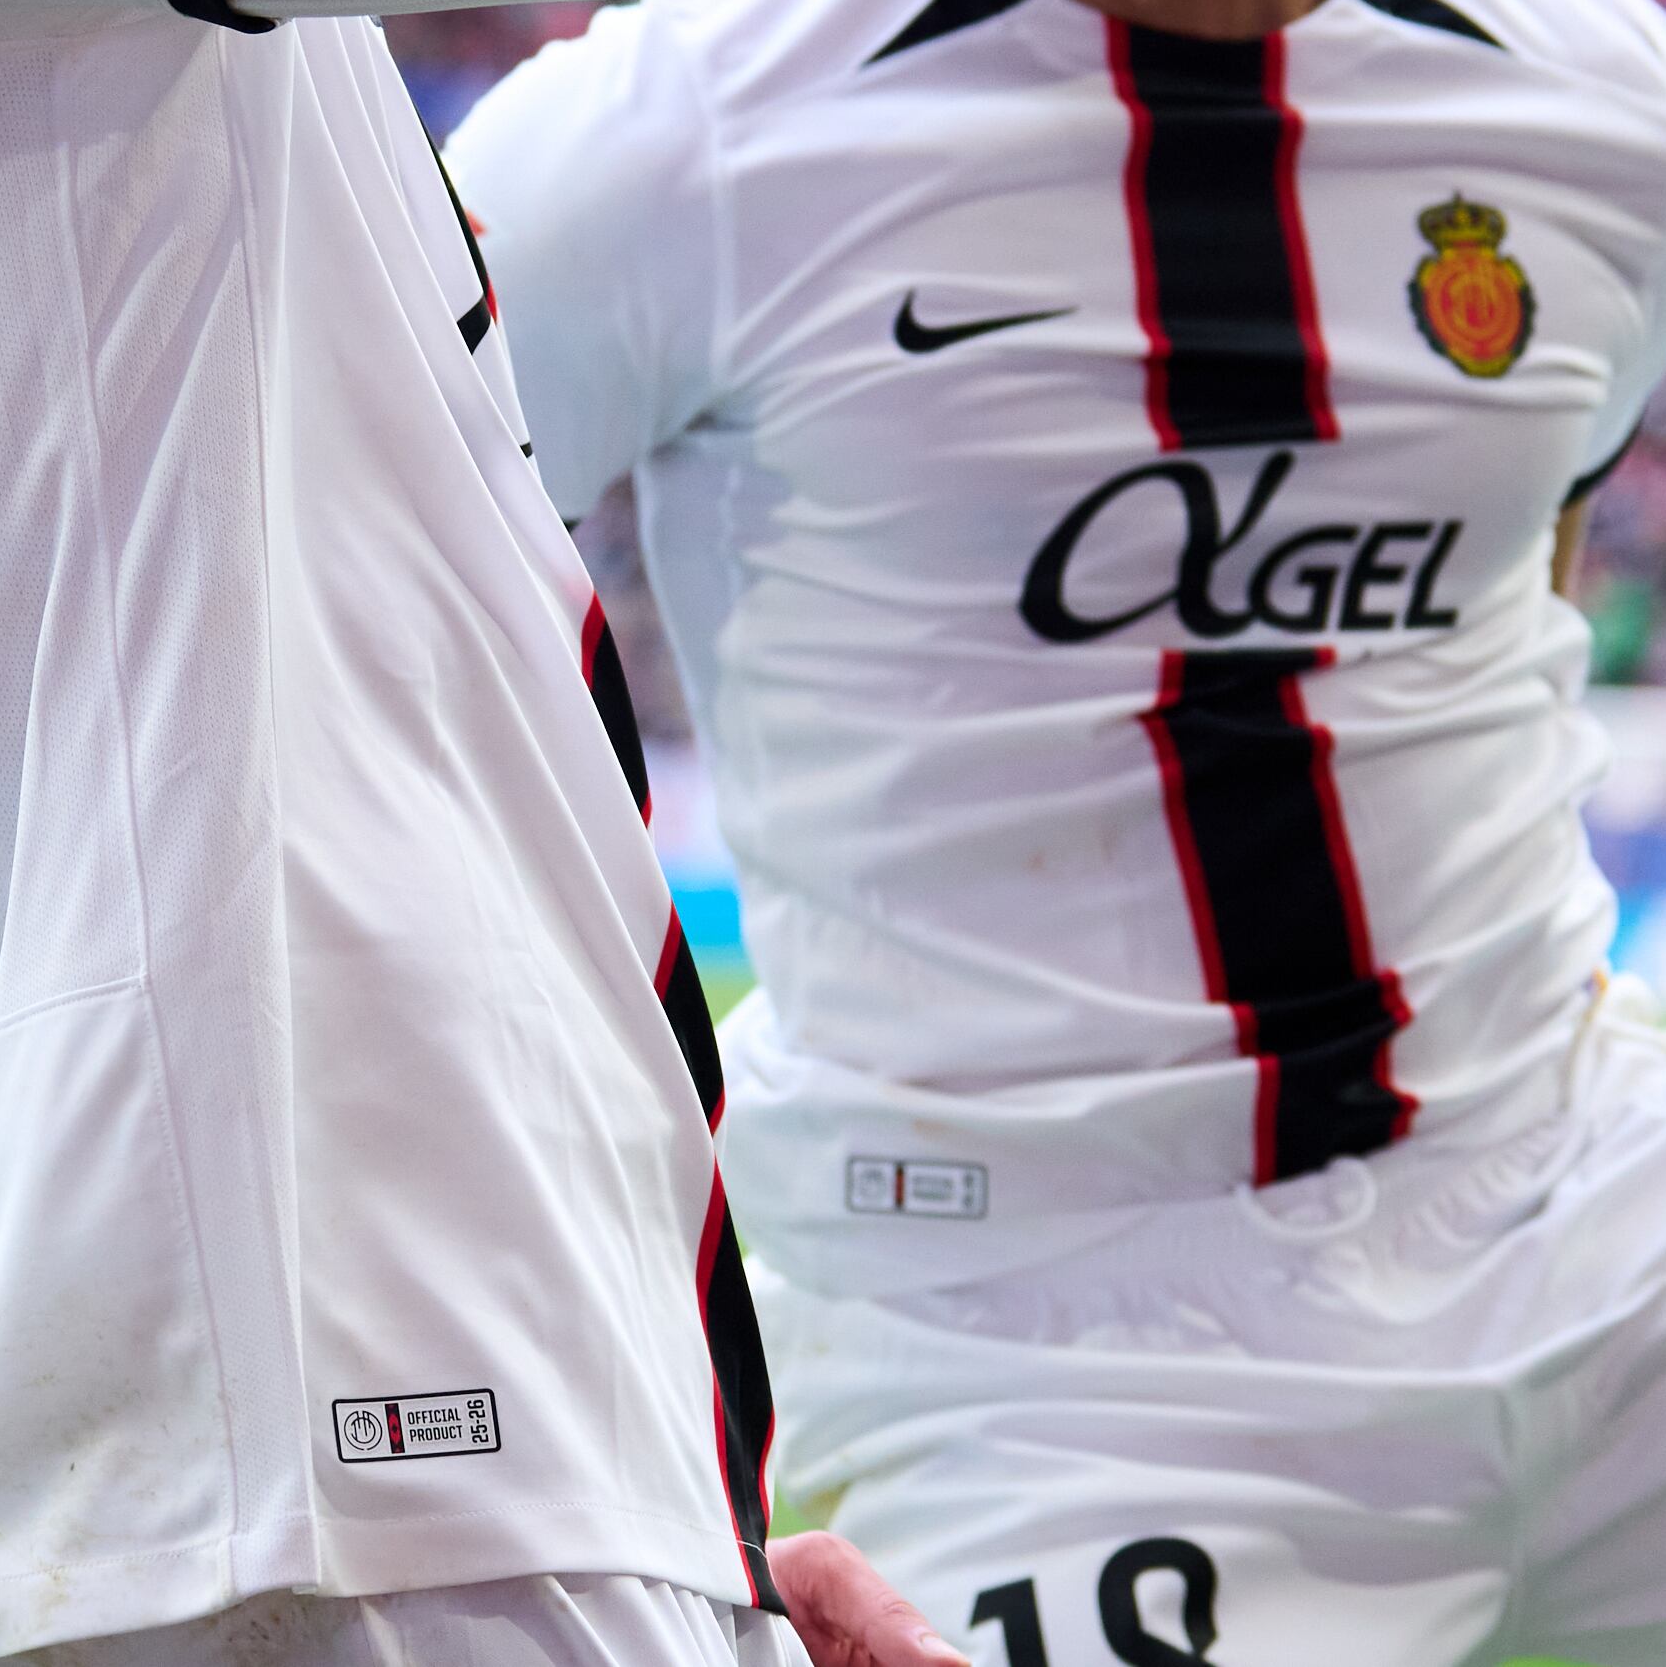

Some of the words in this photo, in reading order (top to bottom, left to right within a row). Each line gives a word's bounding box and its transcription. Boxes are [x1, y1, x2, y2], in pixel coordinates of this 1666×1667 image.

[407, 1407, 461, 1425] OFFICIAL
[467, 1399, 489, 1444] 25-26
[409, 1425, 463, 1442] PRODUCT
